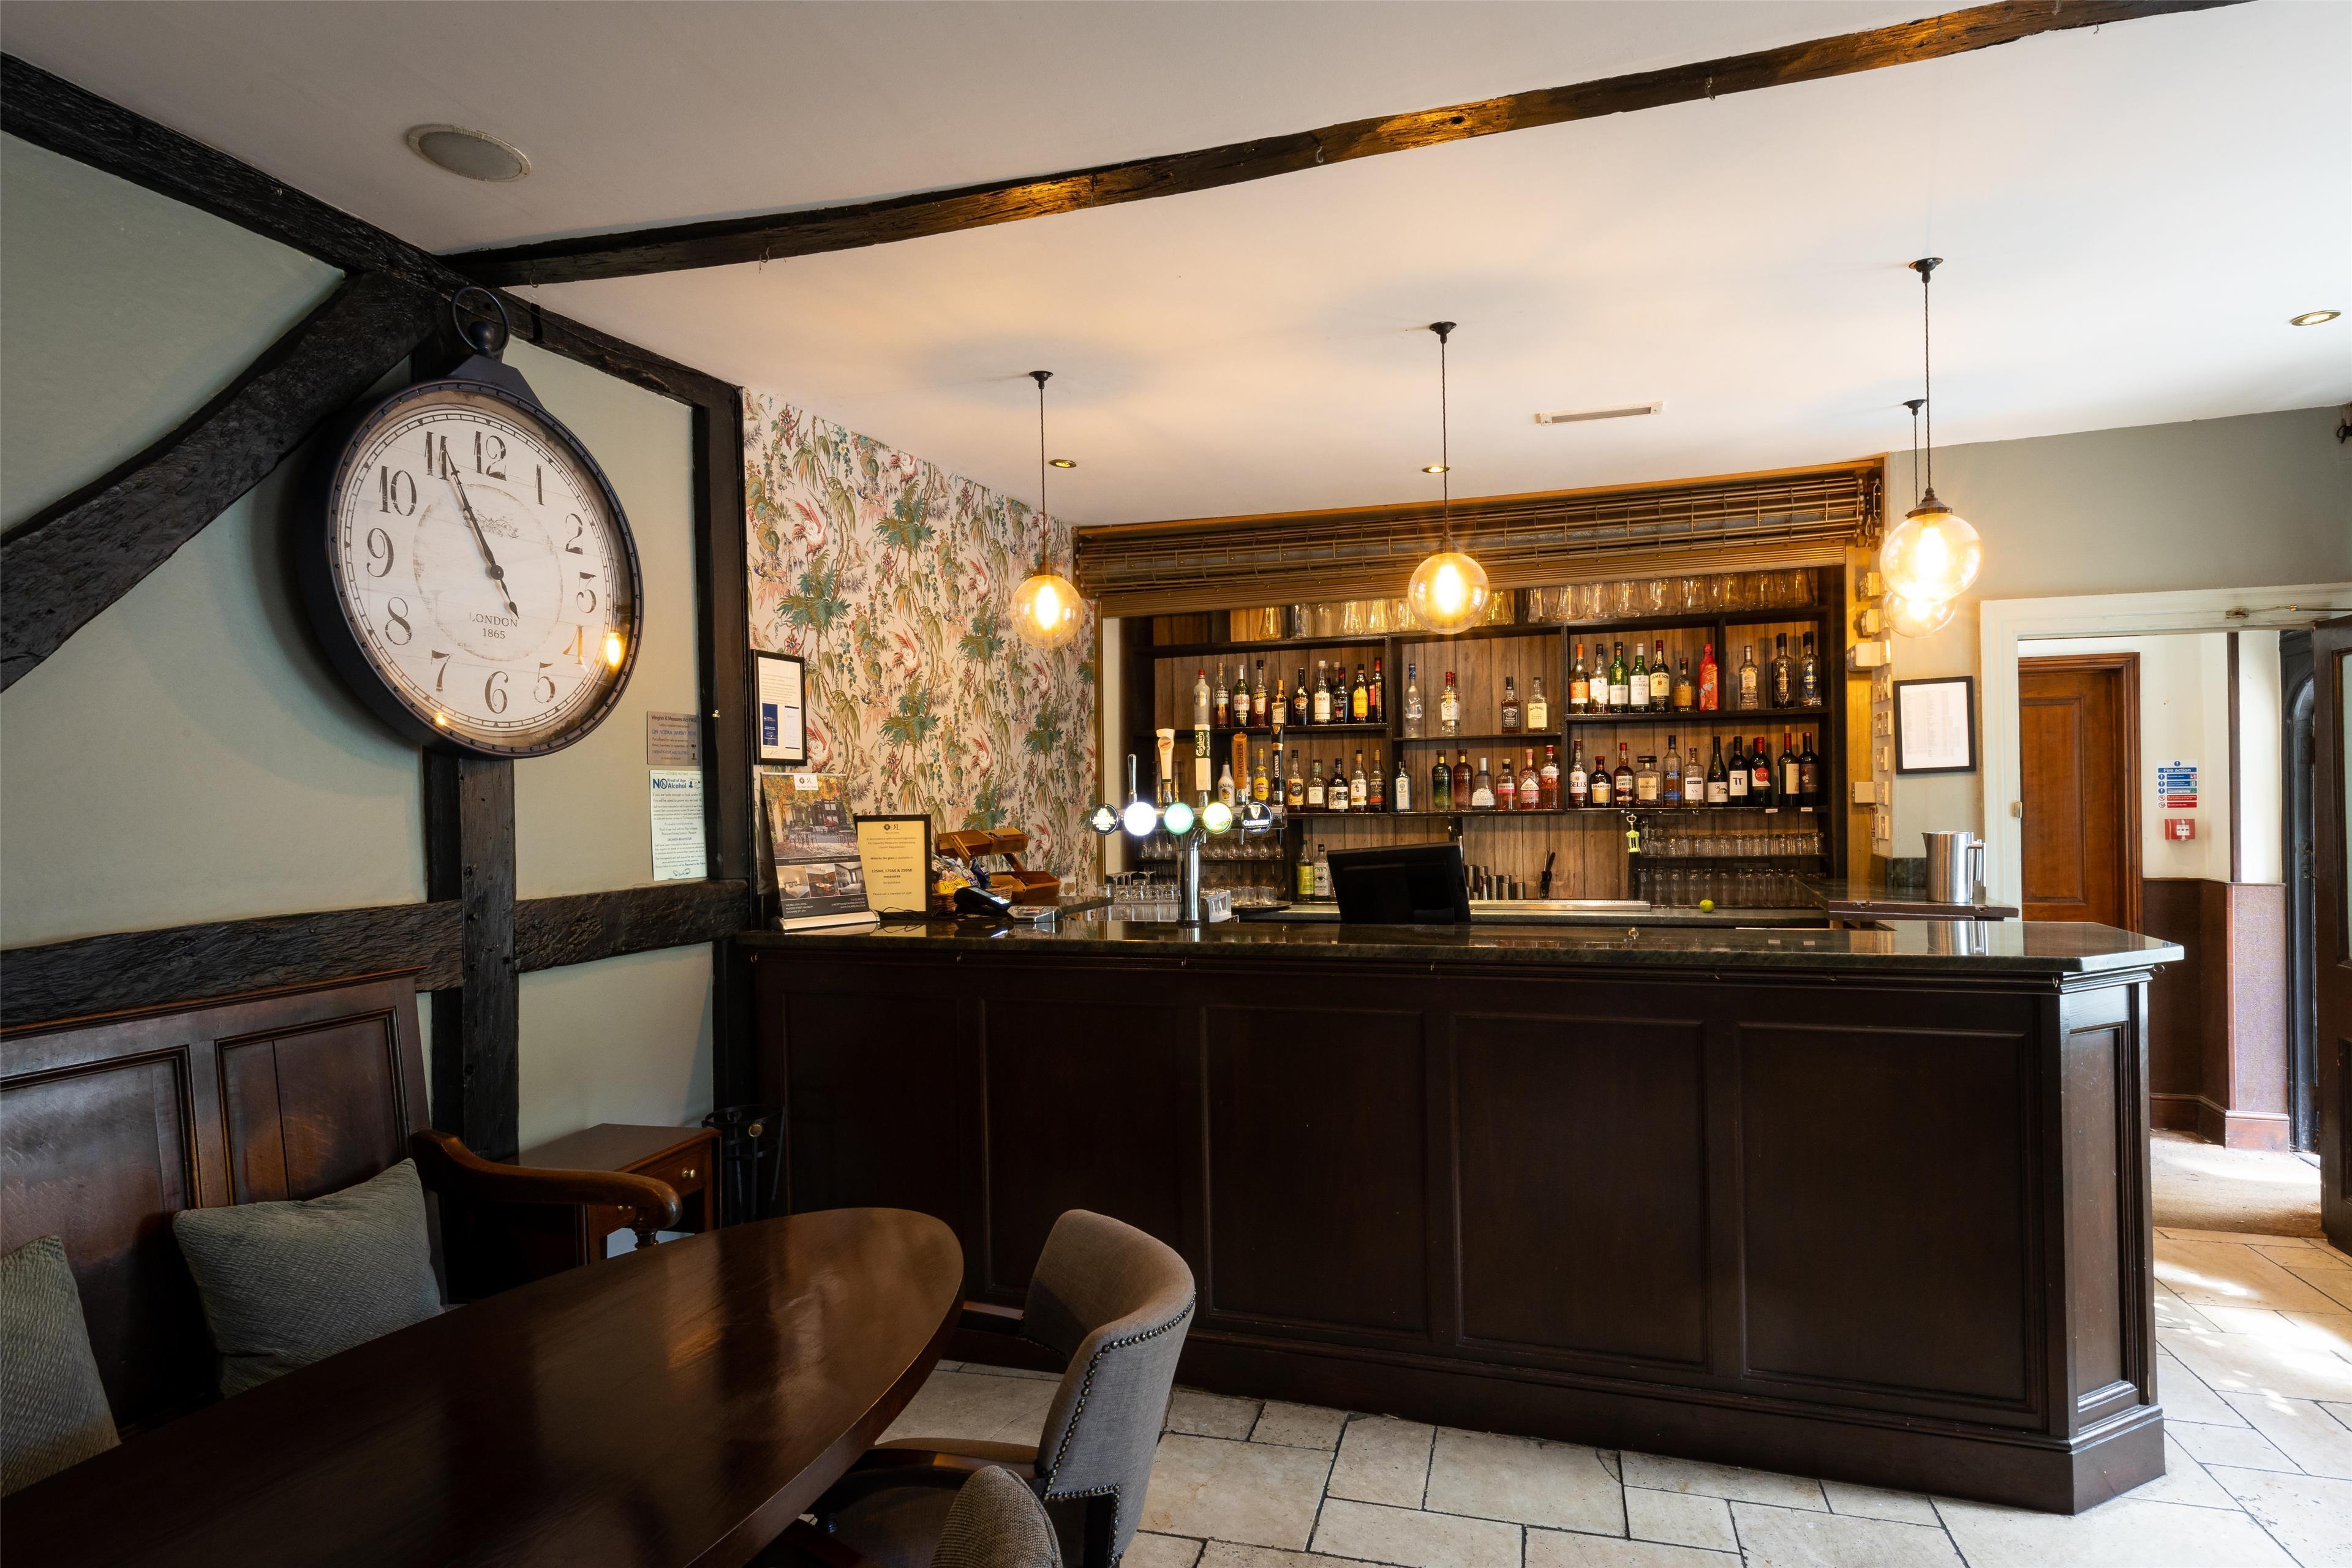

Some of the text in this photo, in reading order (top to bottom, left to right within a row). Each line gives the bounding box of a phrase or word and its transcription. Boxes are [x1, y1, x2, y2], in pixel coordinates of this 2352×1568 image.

[424, 431, 448, 480] 11
[473, 431, 507, 481] 12
[379, 465, 417, 516] 10
[535, 464, 545, 506] 1
[366, 527, 394, 578] 9
[565, 513, 584, 556] 2
[576, 571, 597, 614] 3
[385, 597, 412, 646] 8
[469, 612, 519, 628] LONDON
[482, 627, 506, 640] 1865
[564, 625, 585, 665] 4
[431, 650, 451, 693] 7
[484, 671, 509, 714] 6
[533, 662, 556, 704] 5
[1196, 731, 1205, 756] Carlsberg
